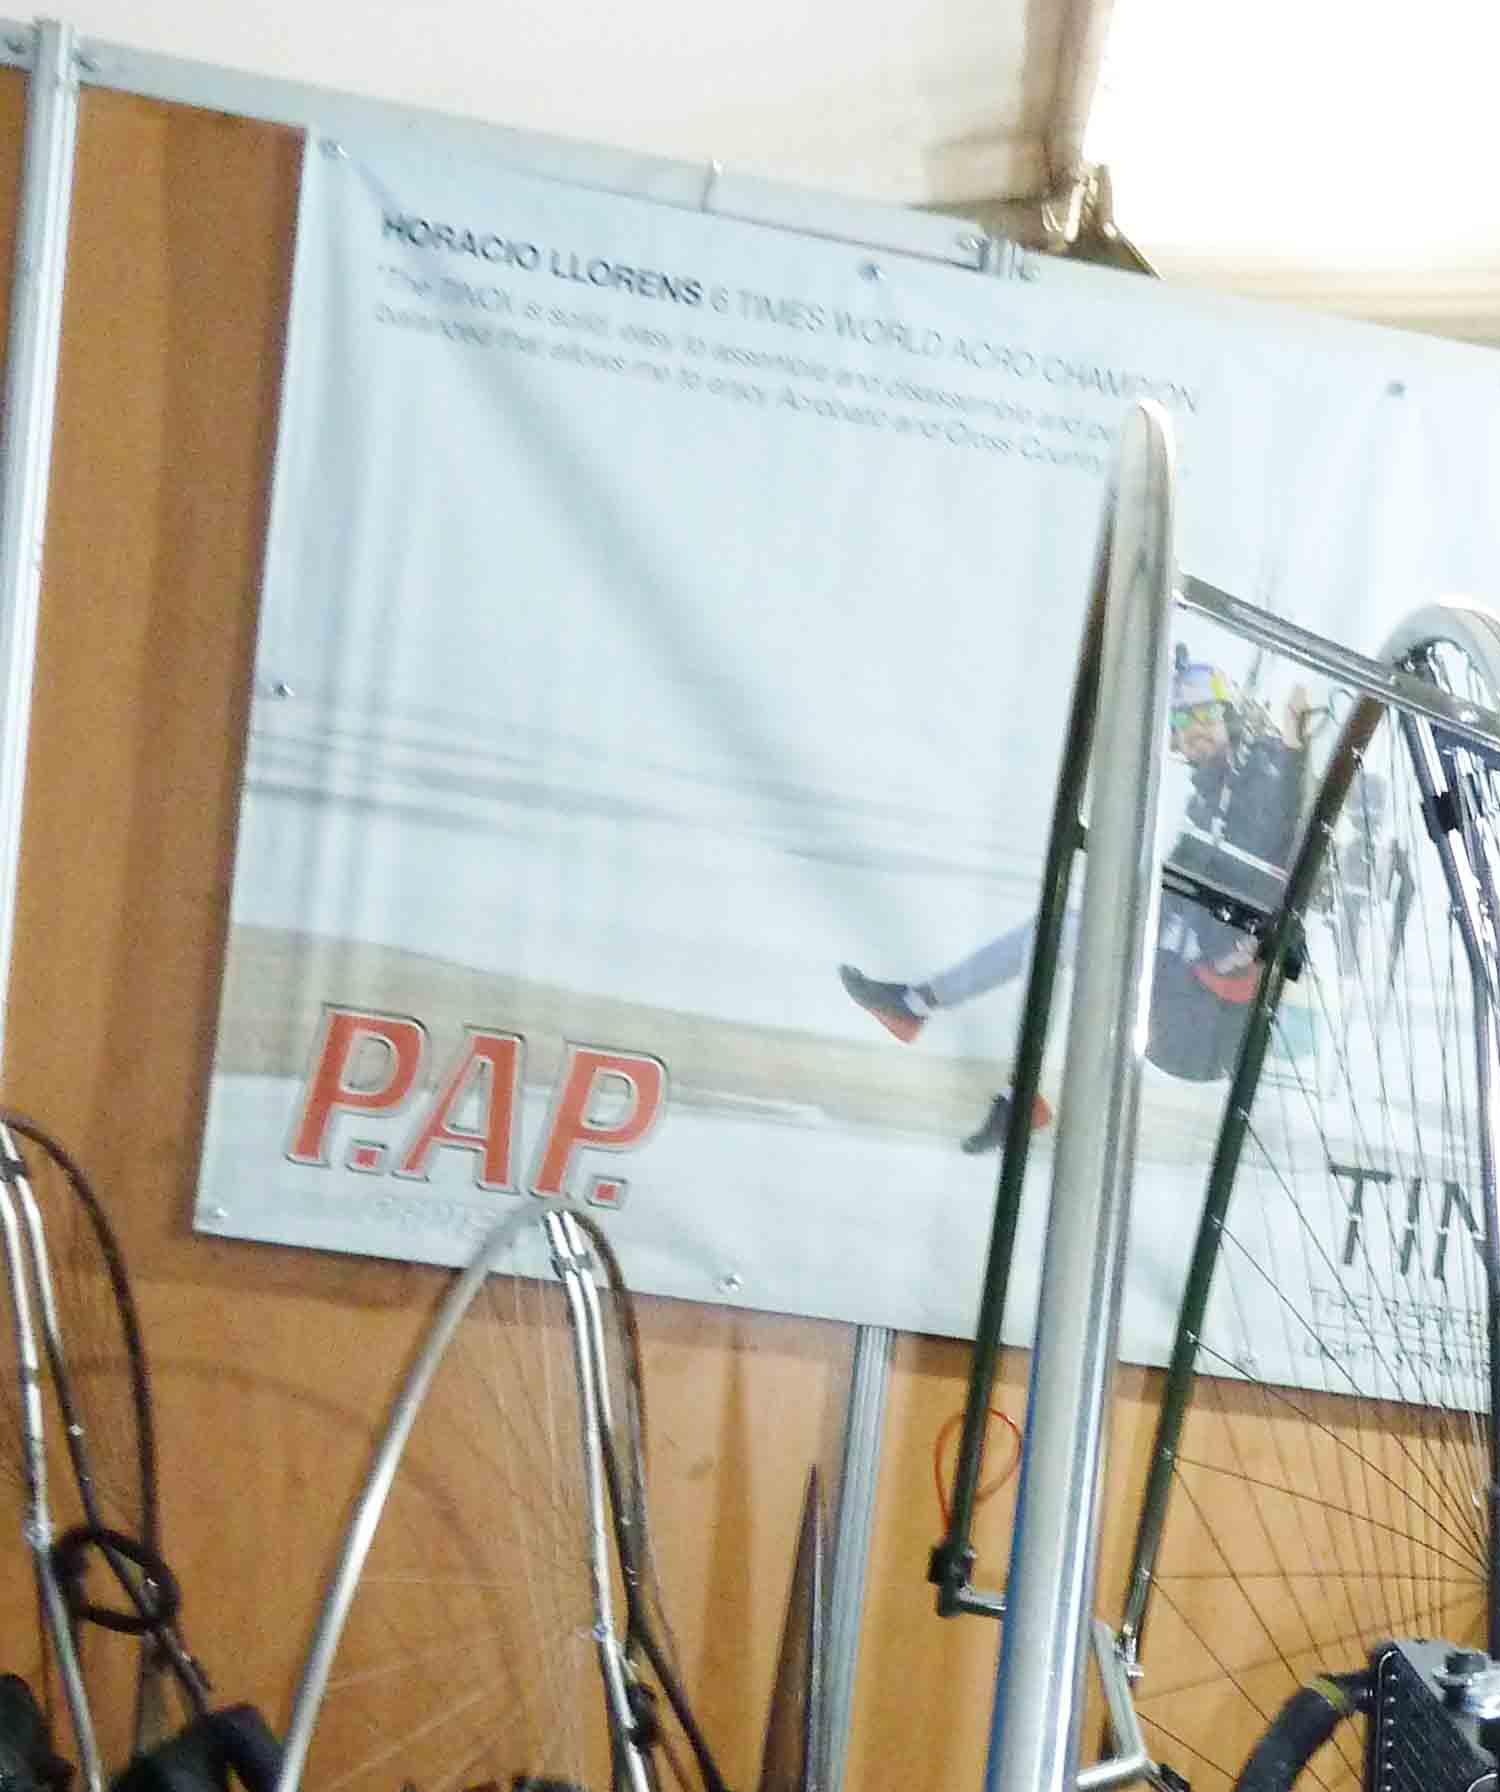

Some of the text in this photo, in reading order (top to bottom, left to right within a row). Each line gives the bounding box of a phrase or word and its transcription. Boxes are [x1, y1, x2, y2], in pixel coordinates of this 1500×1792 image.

[381, 209, 540, 271] HORACIO
[551, 248, 704, 307] LLORENS
[832, 309, 943, 358] WORLD
[951, 335, 1036, 378] ACRO
[285, 1001, 672, 1209] P.A.P.
